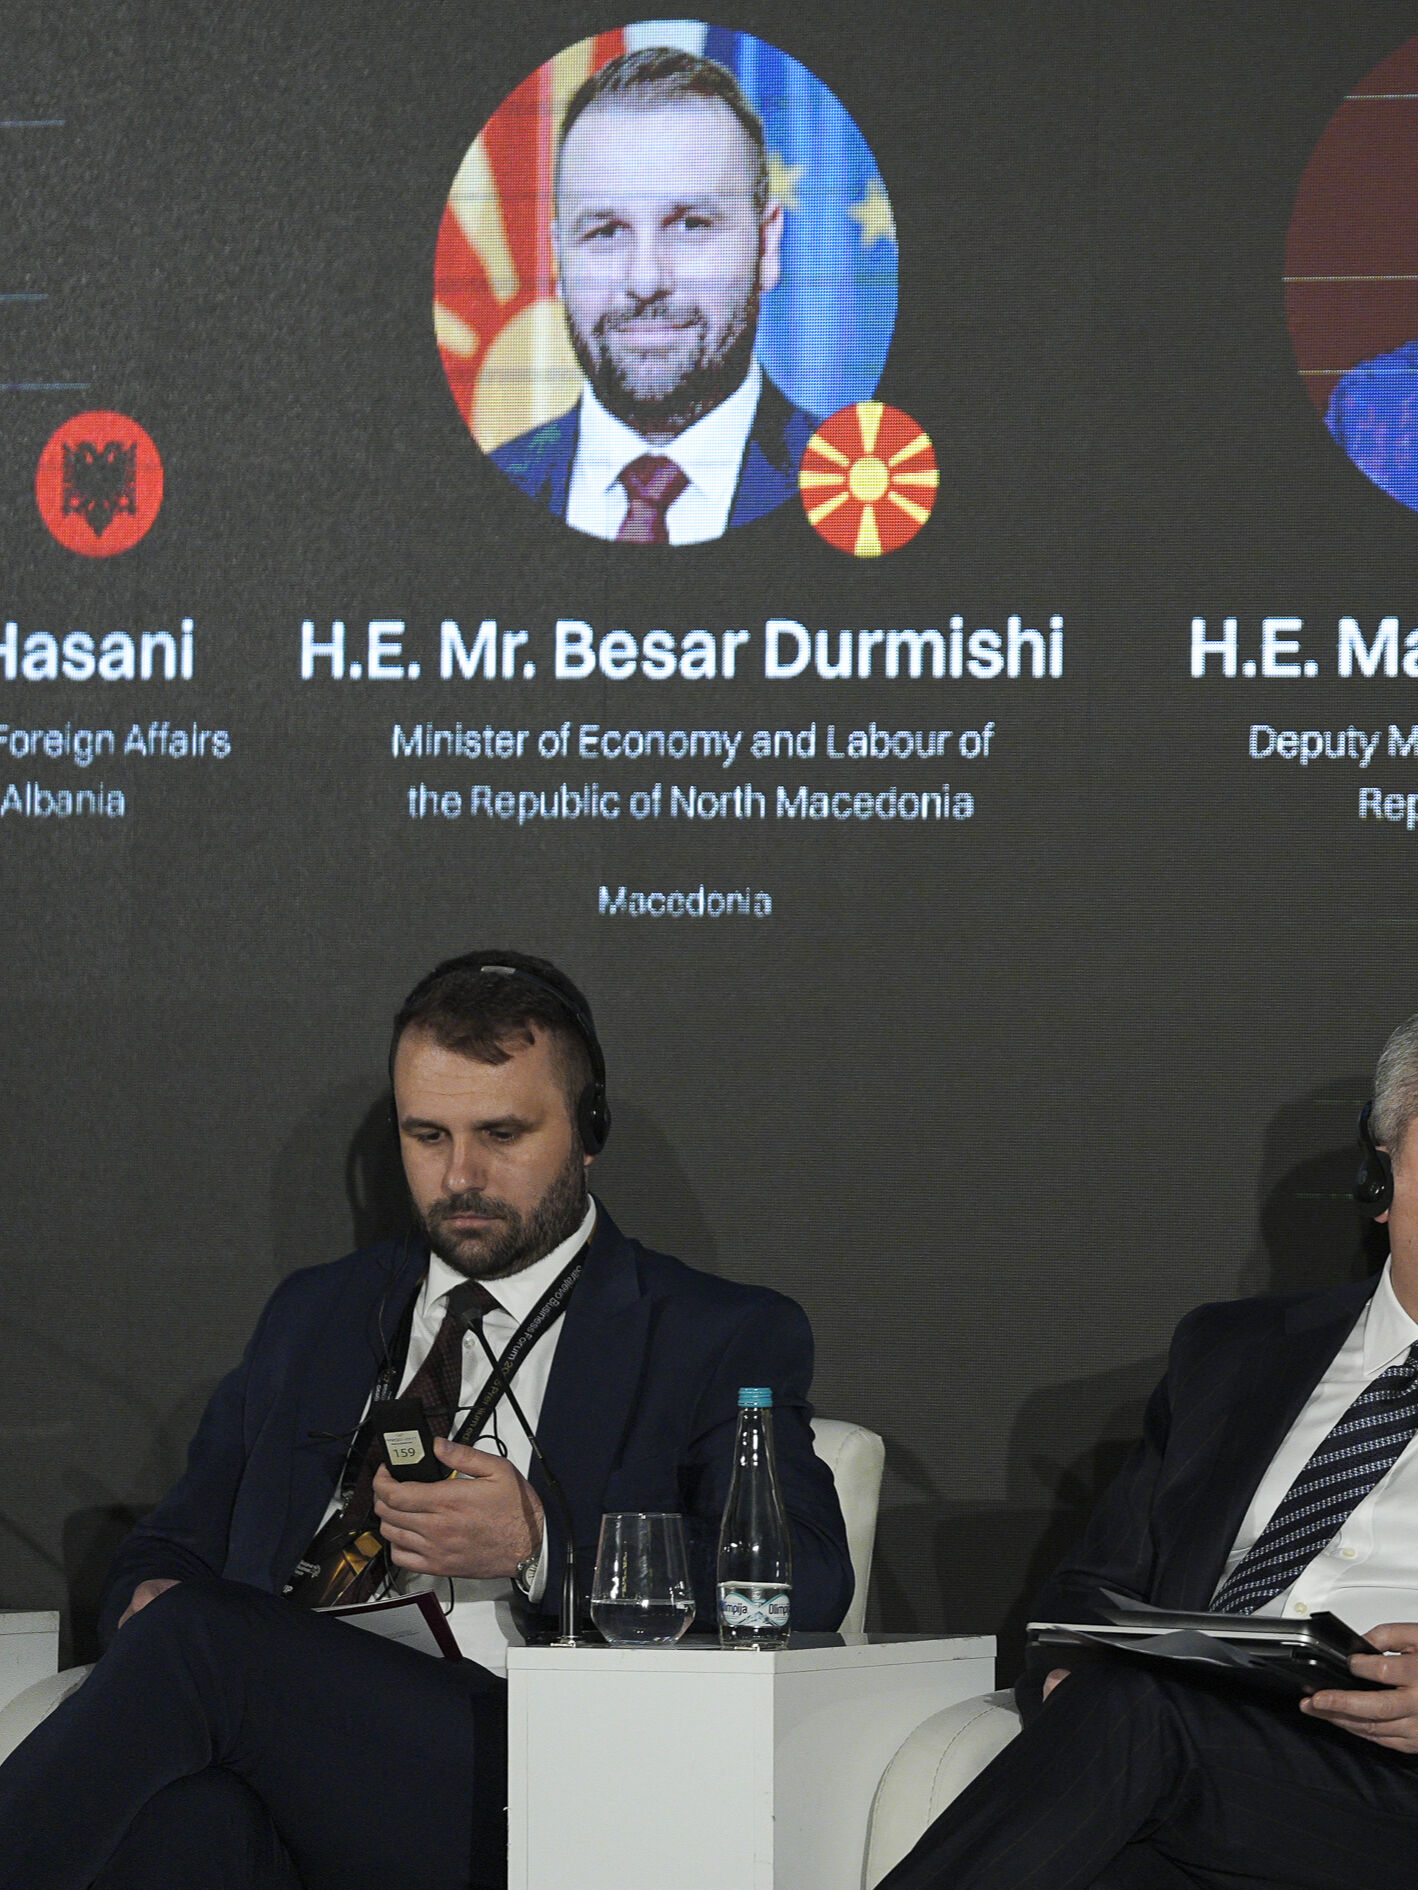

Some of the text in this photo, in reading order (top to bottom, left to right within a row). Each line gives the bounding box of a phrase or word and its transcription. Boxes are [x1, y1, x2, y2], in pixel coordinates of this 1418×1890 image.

[300, 614, 1064, 680] H.E. Mr. Besar Durmishi
[1190, 617, 1319, 678] H.E.
[123, 721, 232, 760] Affairs
[391, 721, 995, 768] Minister of Economy and Labour of
[1248, 724, 1381, 768] Deputy
[1, 781, 126, 818] Albania
[407, 783, 974, 825] the Republic of North Macedonia
[598, 884, 773, 918] Macedonia
[527, 1297, 560, 1333] Business
[508, 1331, 533, 1360] Forum
[392, 1447, 416, 1458] 159
